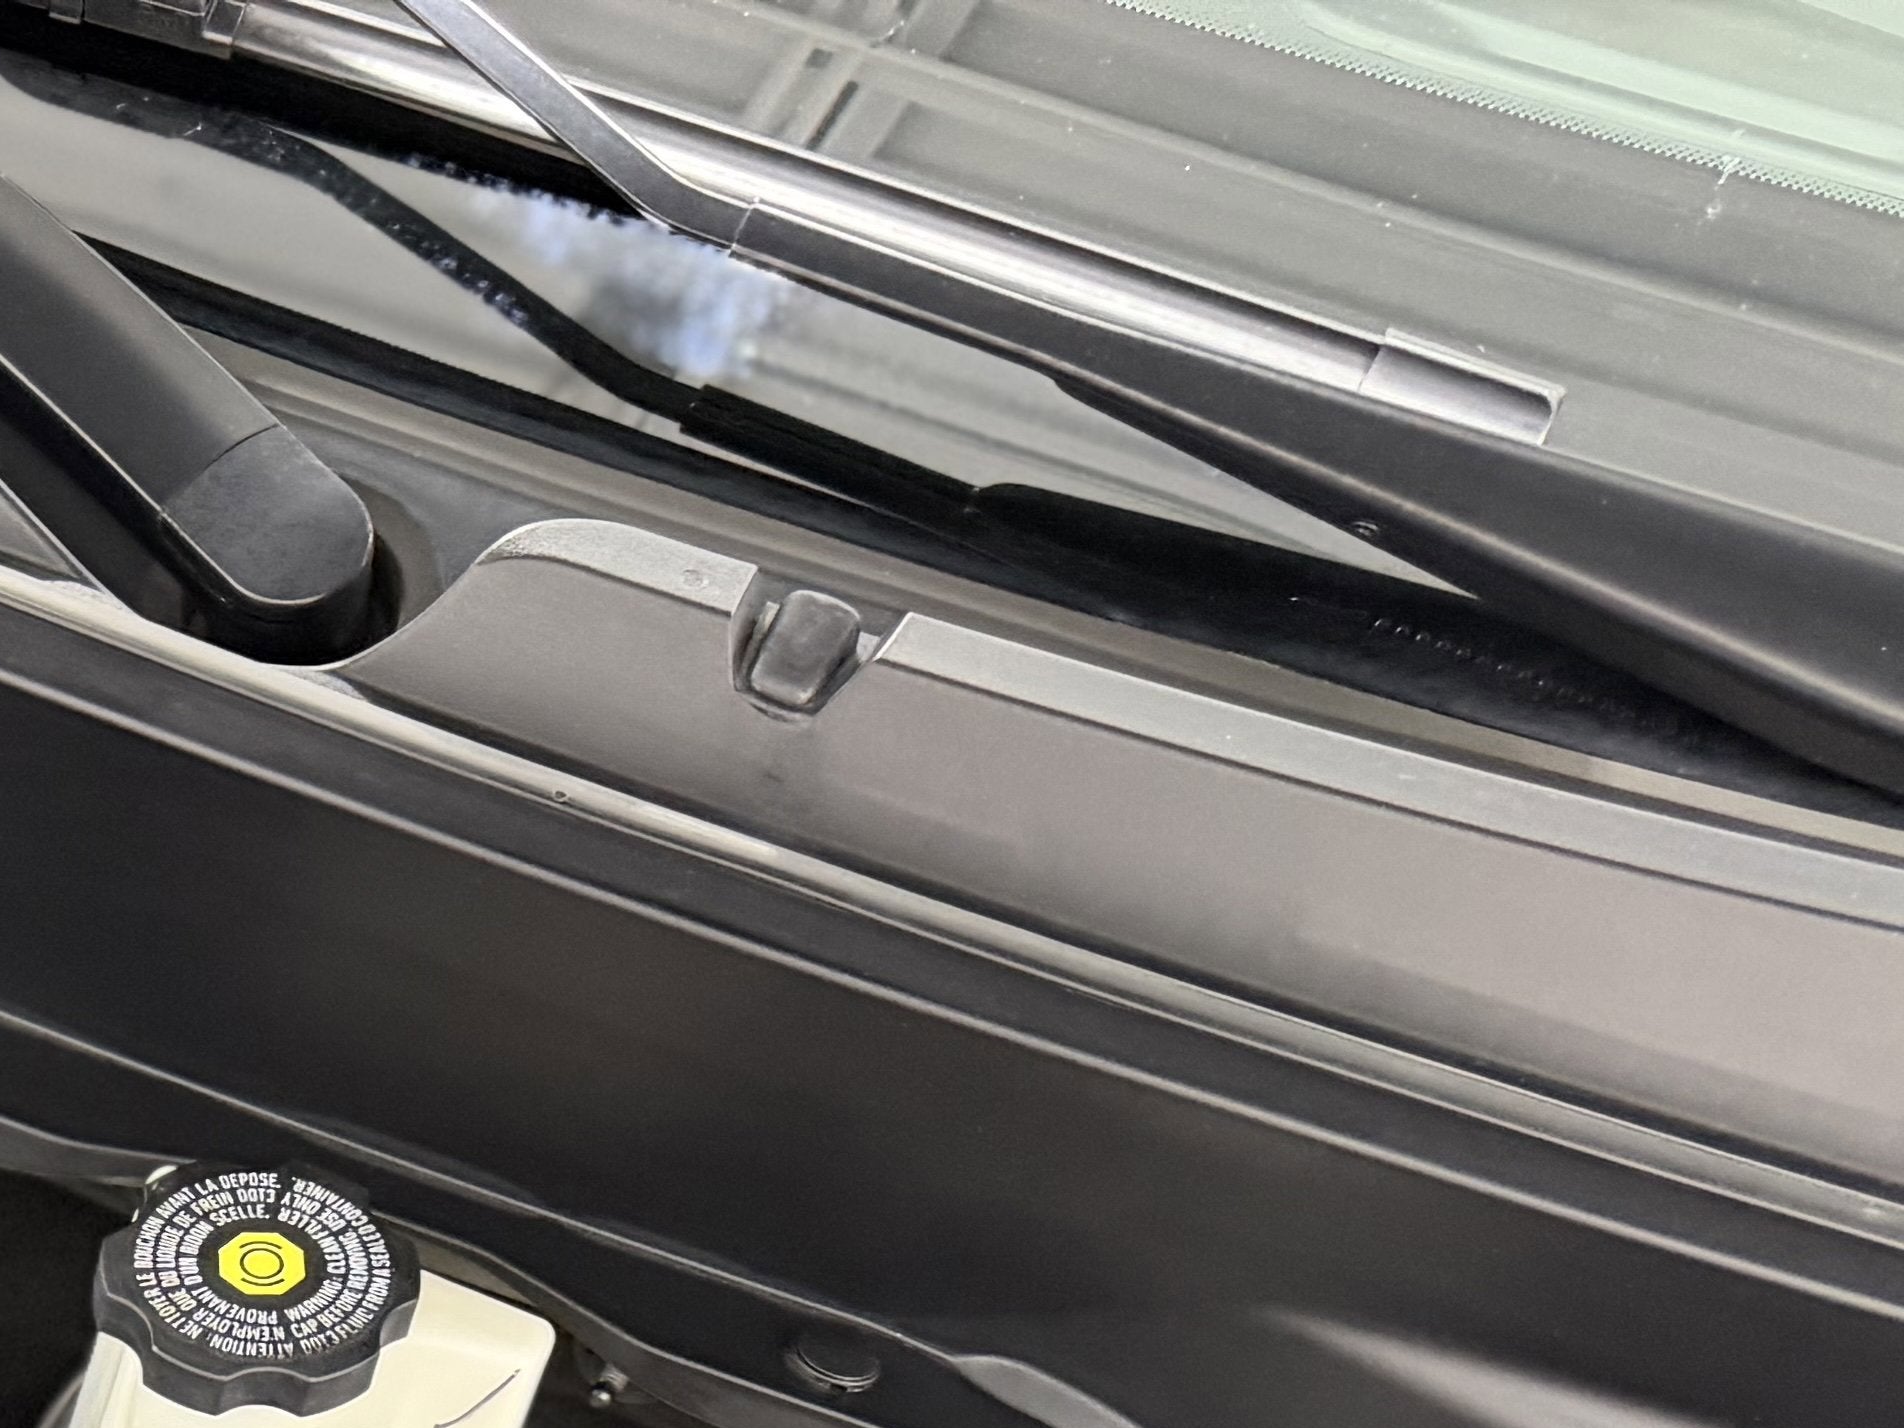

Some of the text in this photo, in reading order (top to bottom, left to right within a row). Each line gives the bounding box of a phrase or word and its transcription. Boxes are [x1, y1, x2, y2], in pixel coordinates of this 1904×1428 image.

[194, 1178, 220, 1196] LA
[219, 1171, 281, 1191] DEPOSE.
[155, 1186, 196, 1219] AVANT
[189, 1190, 235, 1216] FREIN
[236, 1188, 278, 1204] DOT3
[280, 1191, 322, 1215] ONLY
[172, 1210, 197, 1229] DE
[320, 1209, 344, 1232] USE
[133, 1216, 163, 1269] BOUCHON
[157, 1225, 183, 1268] LIQUIDE
[359, 1223, 391, 1268] SEALED
[179, 1203, 278, 1325] PROVENANT D'UN BIDON SCELLE.
[277, 1207, 345, 1322] WARNING: CLEAN FILLER
[135, 1271, 158, 1287] LE
[158, 1270, 181, 1288] DU
[361, 1272, 392, 1311] FROM
[143, 1284, 204, 1340] NETTOYER
[167, 1287, 198, 1312] QUE
[315, 1288, 364, 1328] BEFORE
[290, 1318, 318, 1338] CAP
